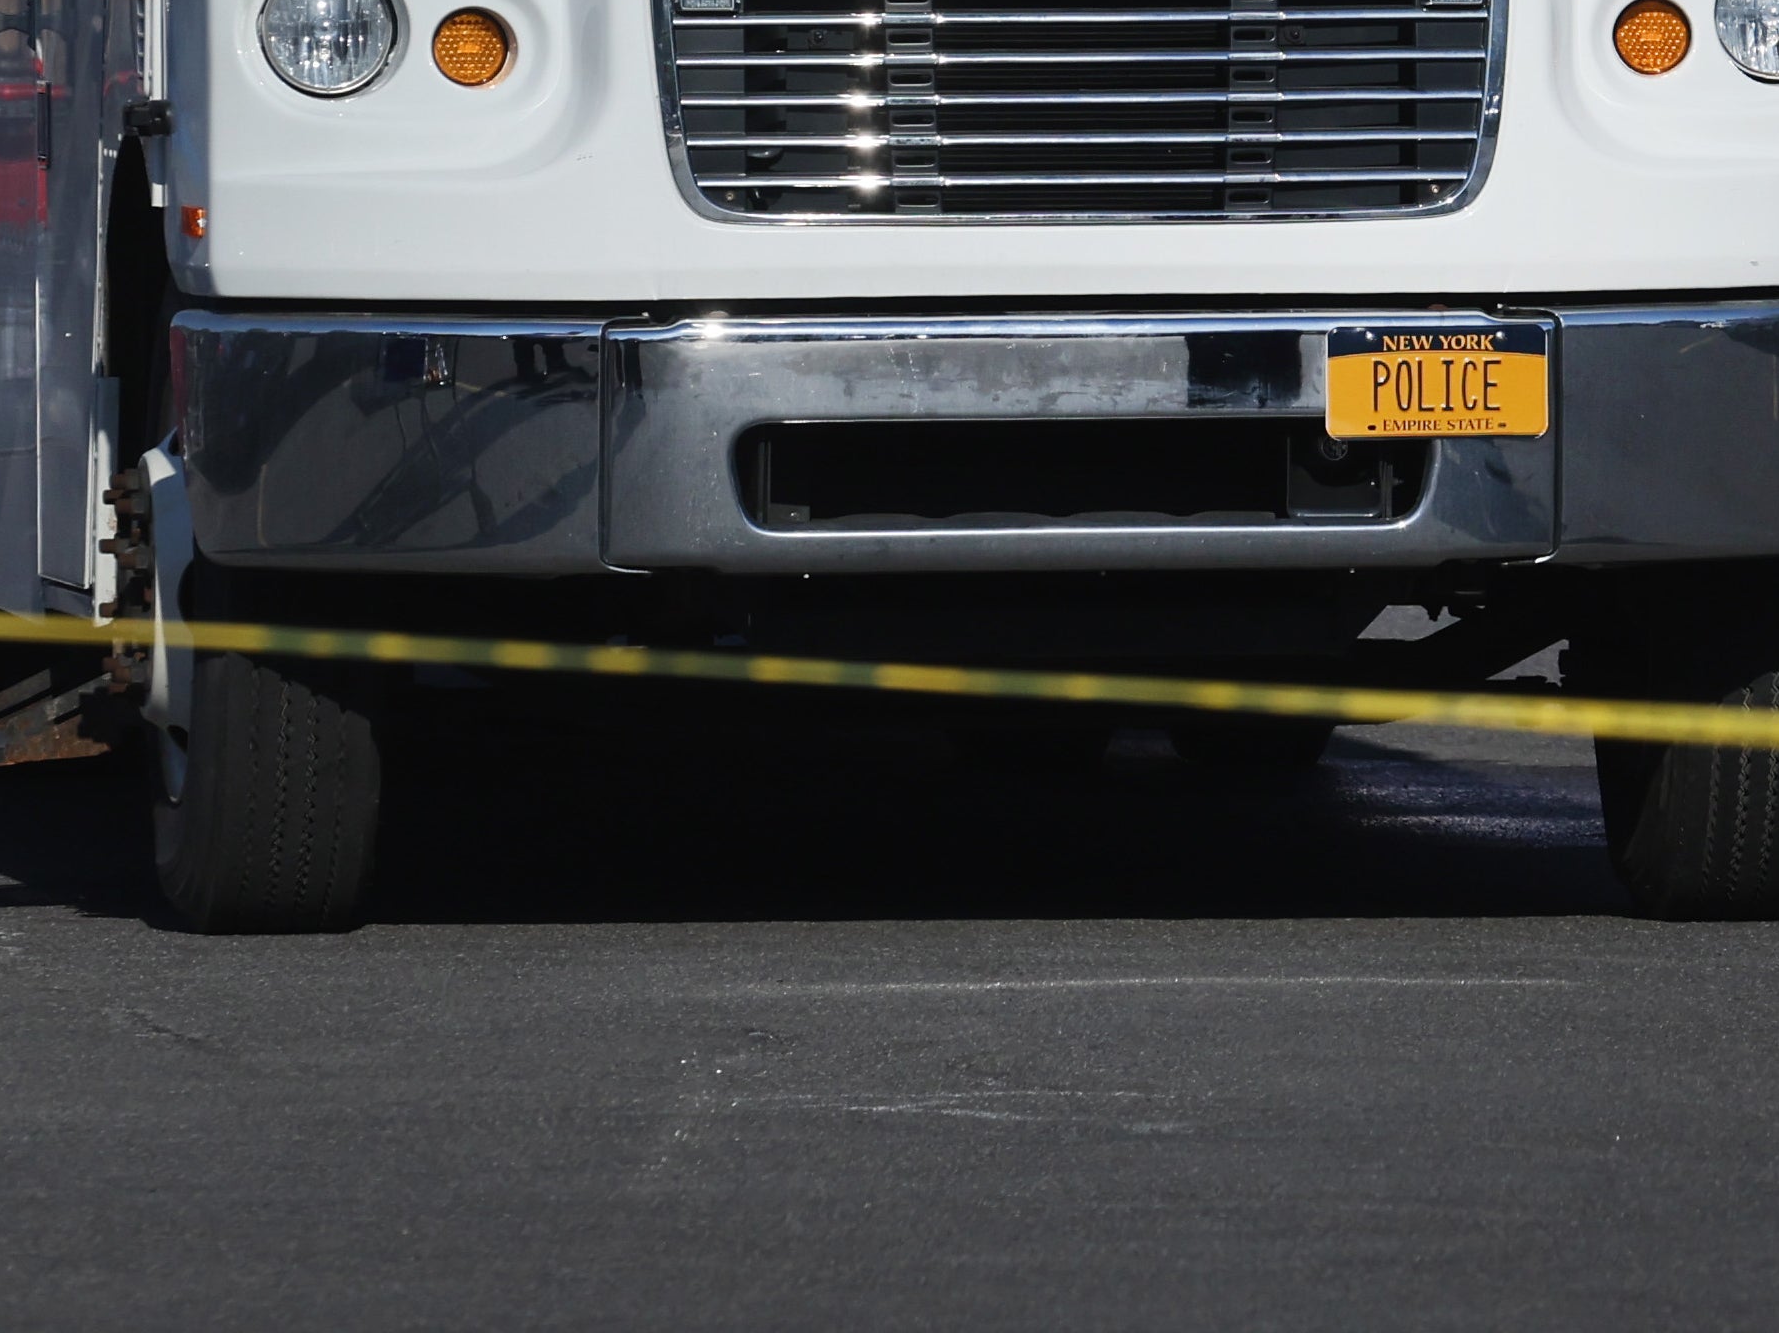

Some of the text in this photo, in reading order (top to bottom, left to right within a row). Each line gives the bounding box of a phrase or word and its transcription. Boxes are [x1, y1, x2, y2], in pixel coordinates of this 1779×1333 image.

[1382, 334, 1494, 351] NEW YORK
[1373, 359, 1502, 412] POLICE
[1382, 418, 1494, 432] EMPIRE STATE
